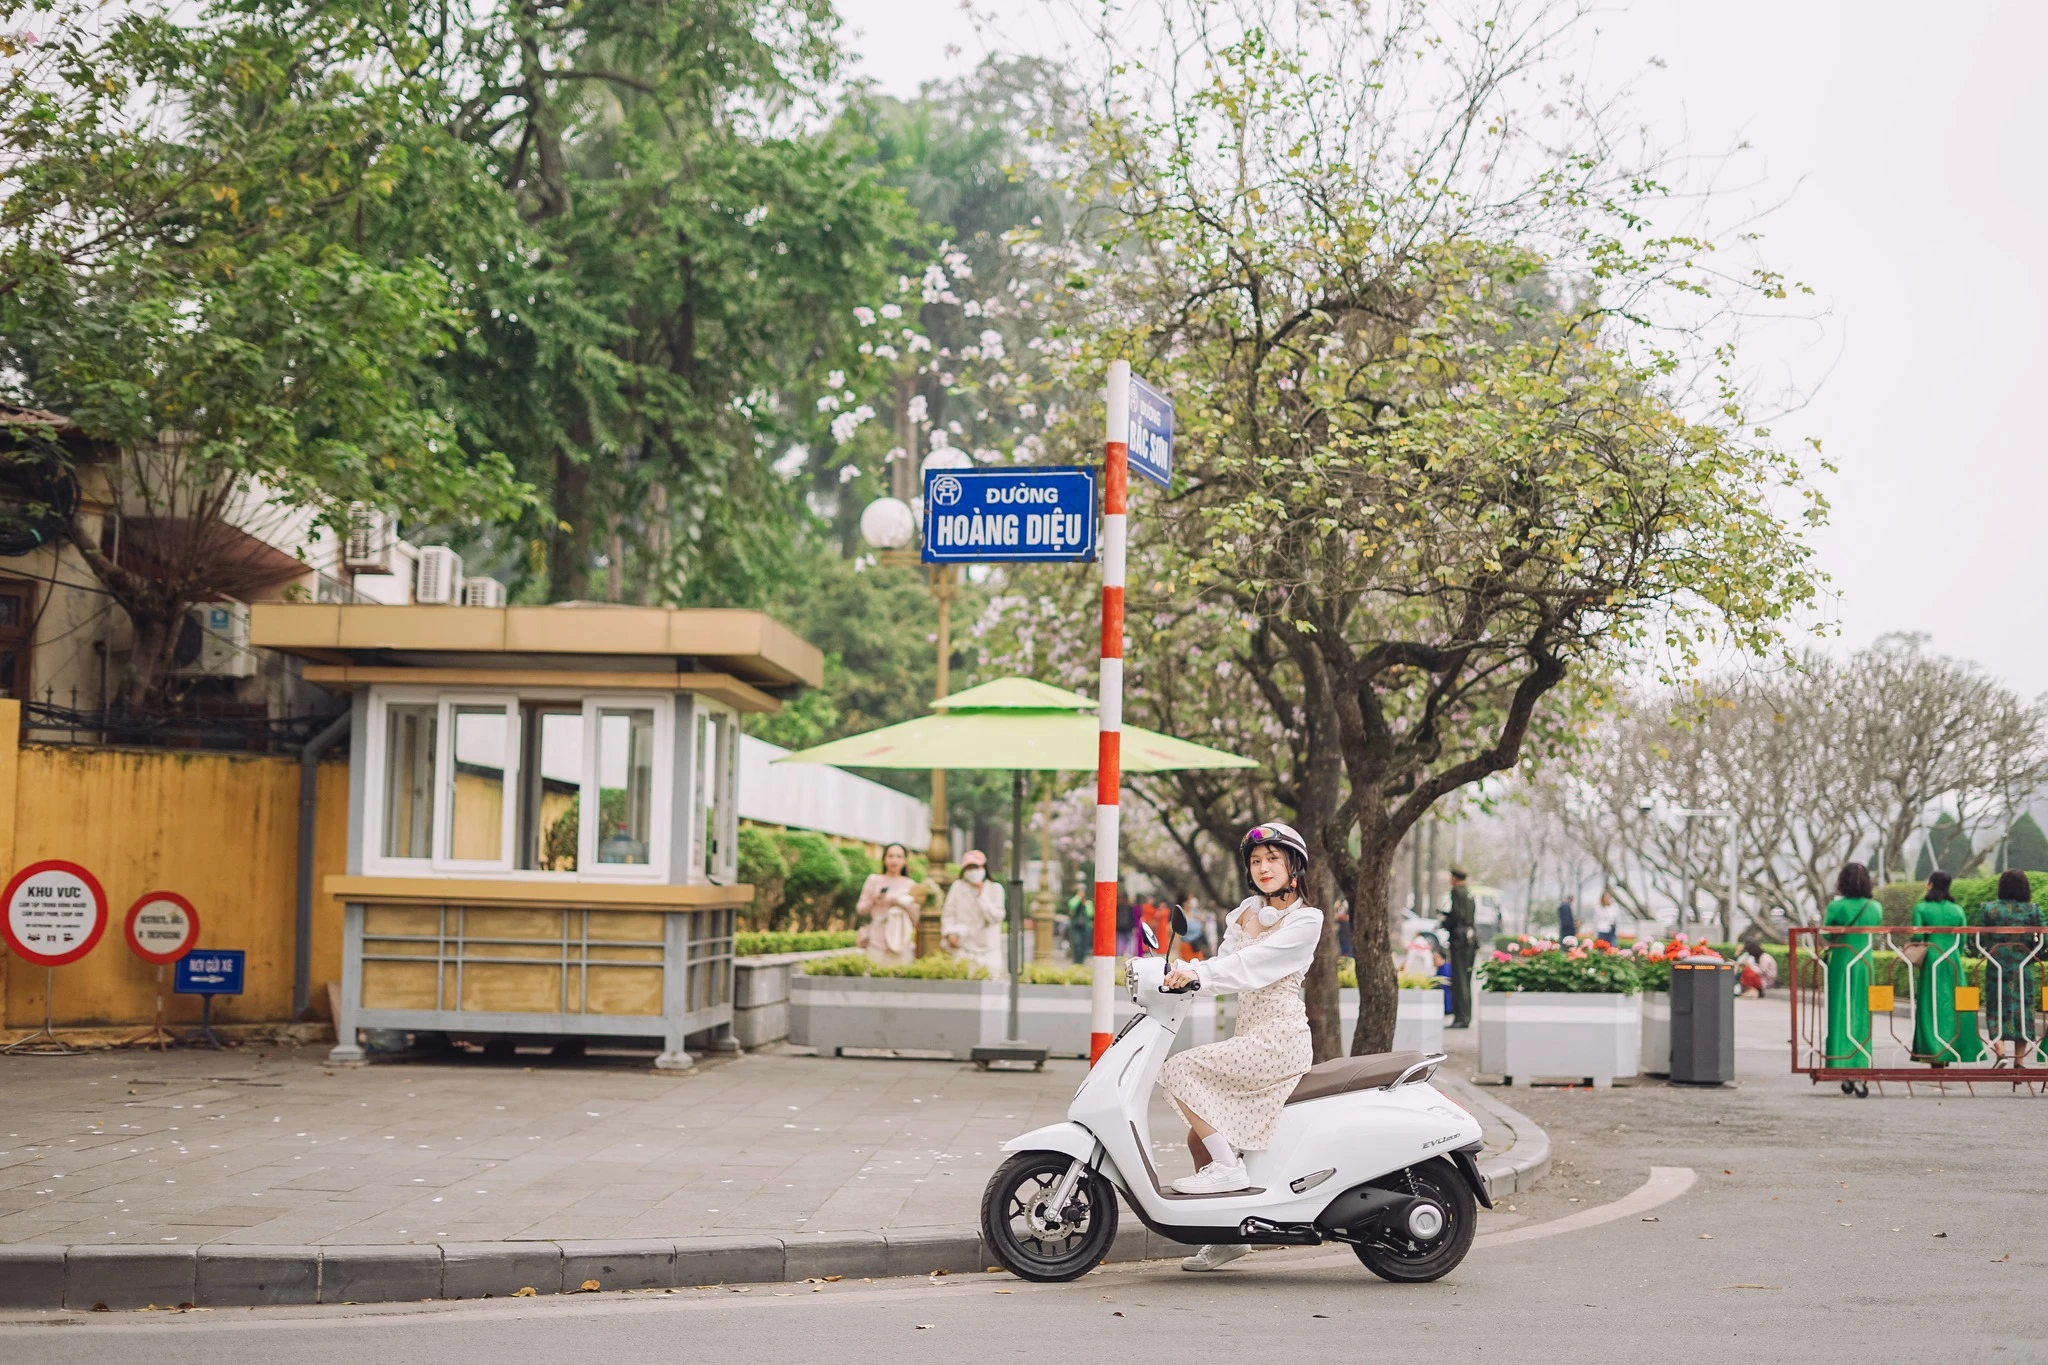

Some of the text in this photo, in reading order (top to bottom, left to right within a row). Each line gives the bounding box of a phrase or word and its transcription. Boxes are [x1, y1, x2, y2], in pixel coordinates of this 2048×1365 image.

[1150, 432, 1168, 471] SƠN
[985, 482, 1059, 504] ĐƯỜNG
[937, 507, 1082, 551] HOÀNG DIỆU
[27, 886, 53, 898] KHU
